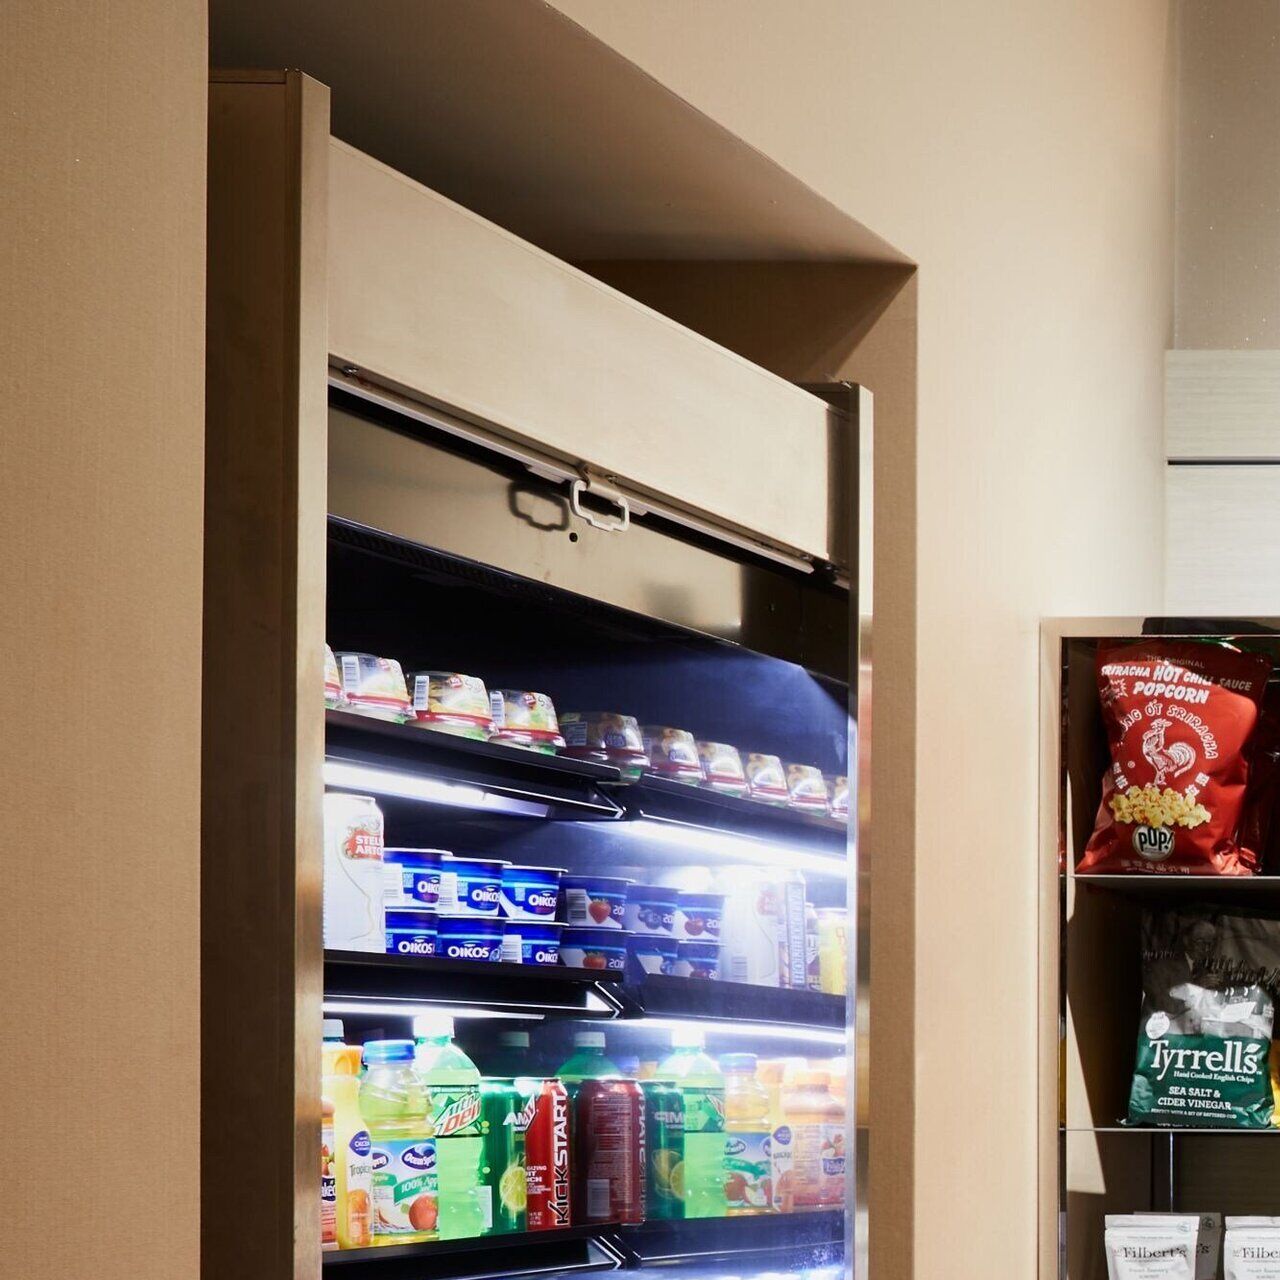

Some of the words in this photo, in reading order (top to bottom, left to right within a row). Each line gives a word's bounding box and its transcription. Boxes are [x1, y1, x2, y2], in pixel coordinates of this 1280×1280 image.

[1153, 665, 1183, 683] HOT
[1218, 677, 1252, 691] SAUCE
[1133, 682, 1210, 704] POPCORN
[398, 941, 433, 955] OIKOS
[448, 946, 490, 958] OIKOS
[1190, 1072, 1213, 1080] Cooked
[1214, 1074, 1236, 1082] English
[1236, 1075, 1255, 1084] Chips
[1169, 1086, 1187, 1095] SEA
[1188, 1087, 1213, 1098] SALT
[1213, 1090, 1221, 1098] &
[1157, 1097, 1186, 1107] CIDER
[1187, 1098, 1233, 1110] VINEGAR
[548, 1090, 570, 1226] KICKSTART
[1123, 1247, 1187, 1259] Filbert's
